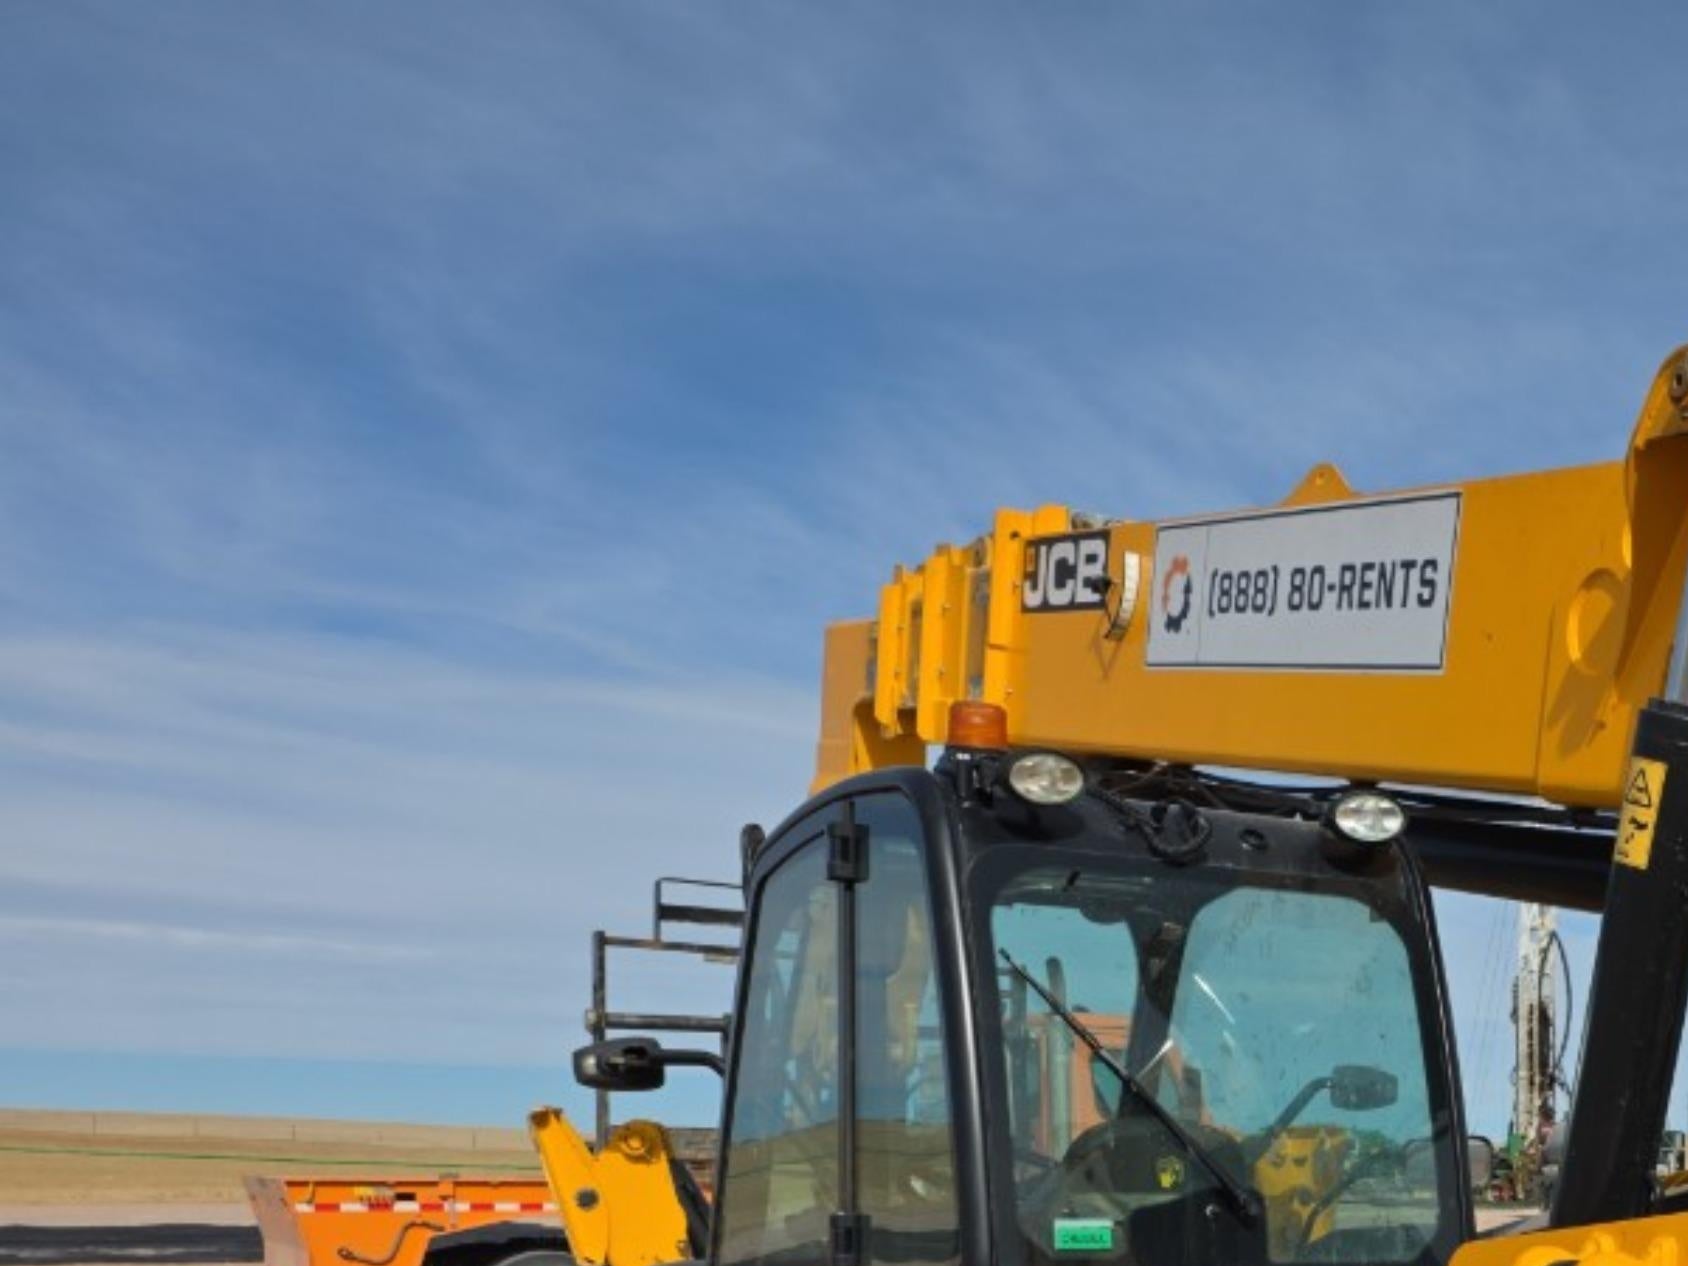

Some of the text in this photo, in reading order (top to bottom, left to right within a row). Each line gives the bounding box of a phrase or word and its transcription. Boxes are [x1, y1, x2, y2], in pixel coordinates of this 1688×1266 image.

[1023, 539, 1107, 609] JCB
[1208, 558, 1439, 618] (888) 80-RENTS
